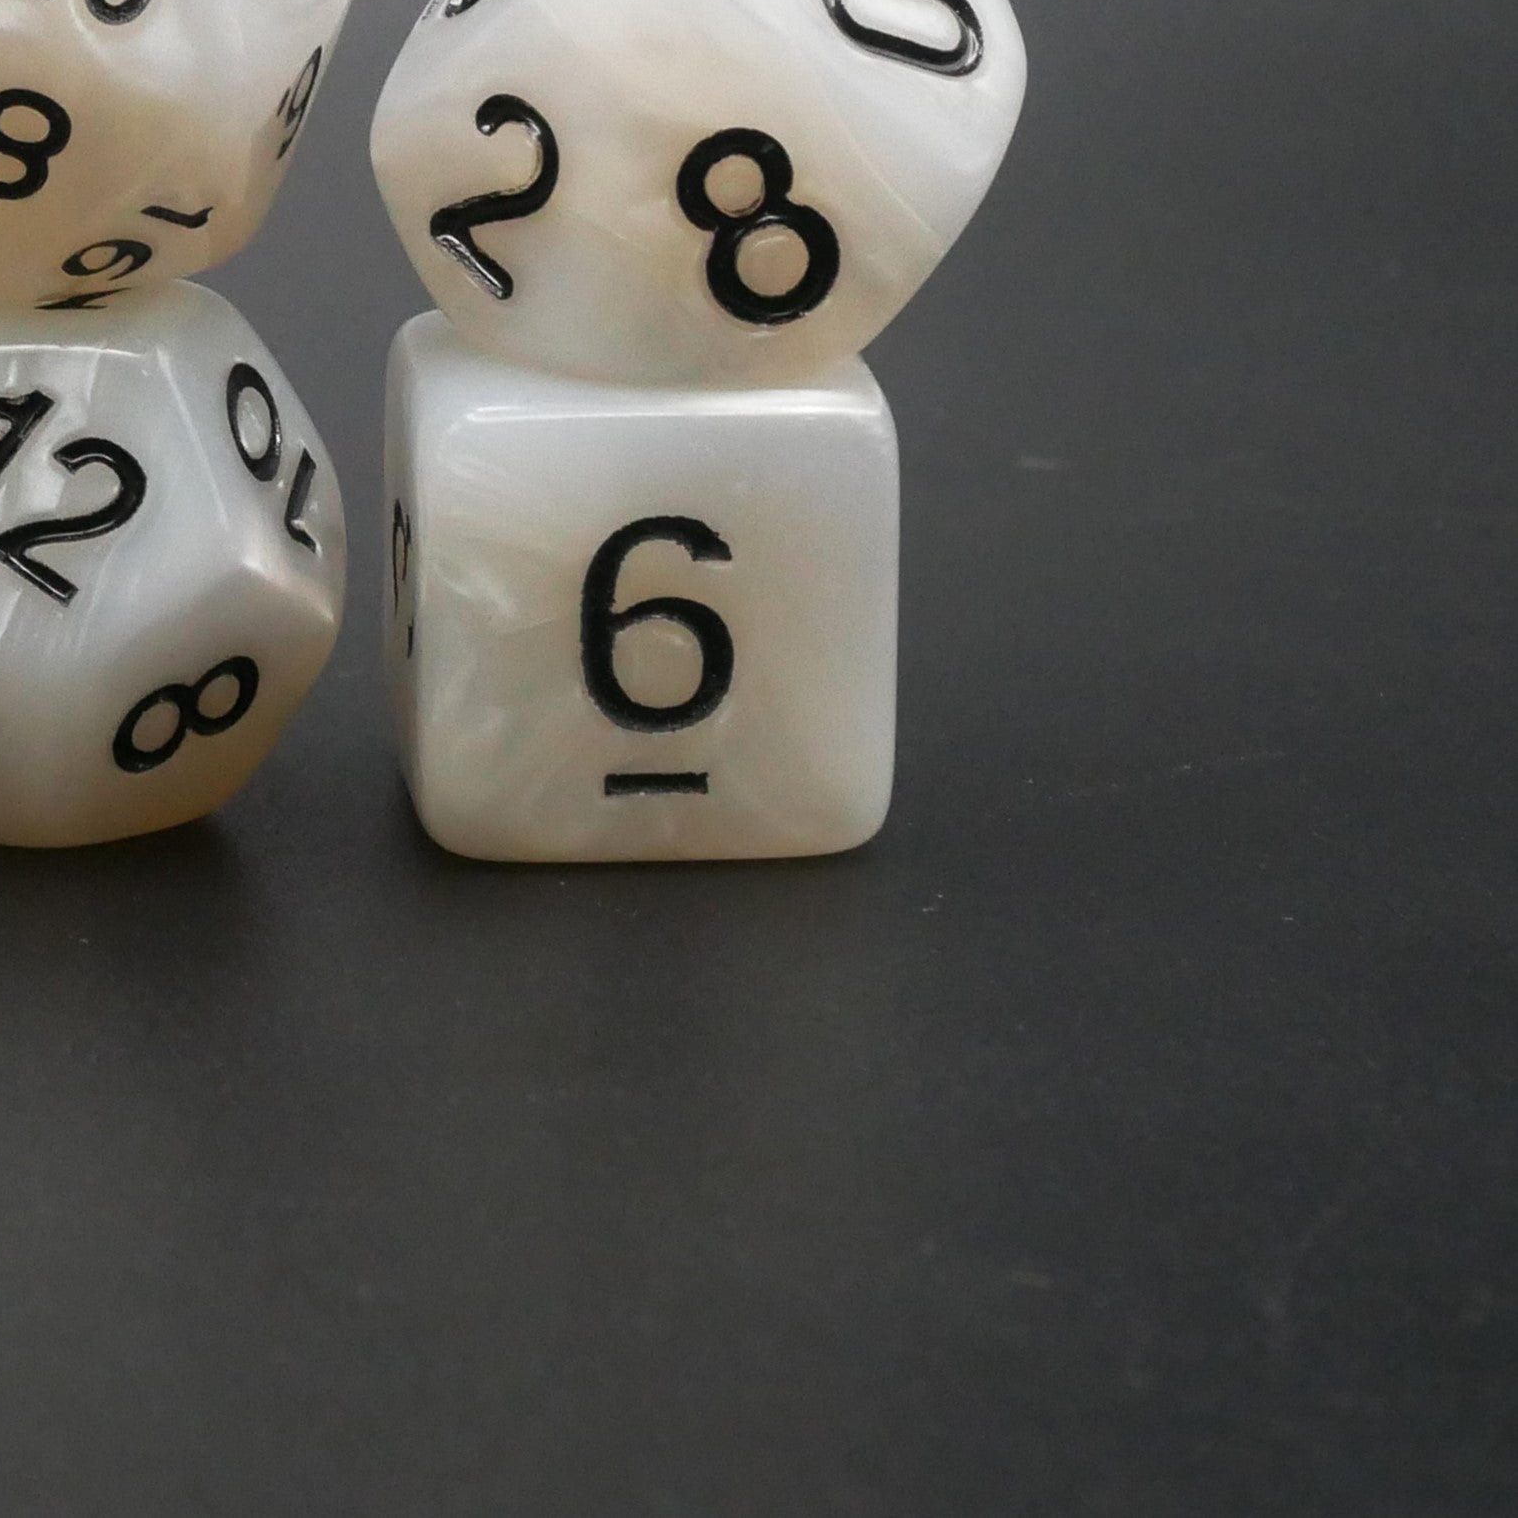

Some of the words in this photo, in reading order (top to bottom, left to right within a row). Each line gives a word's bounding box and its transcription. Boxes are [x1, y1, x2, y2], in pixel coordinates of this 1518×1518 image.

[430, 94, 560, 300] 2
[676, 128, 842, 326] 8
[225, 362, 319, 554] 10
[112, 655, 260, 774] 8
[580, 515, 735, 734] 6
